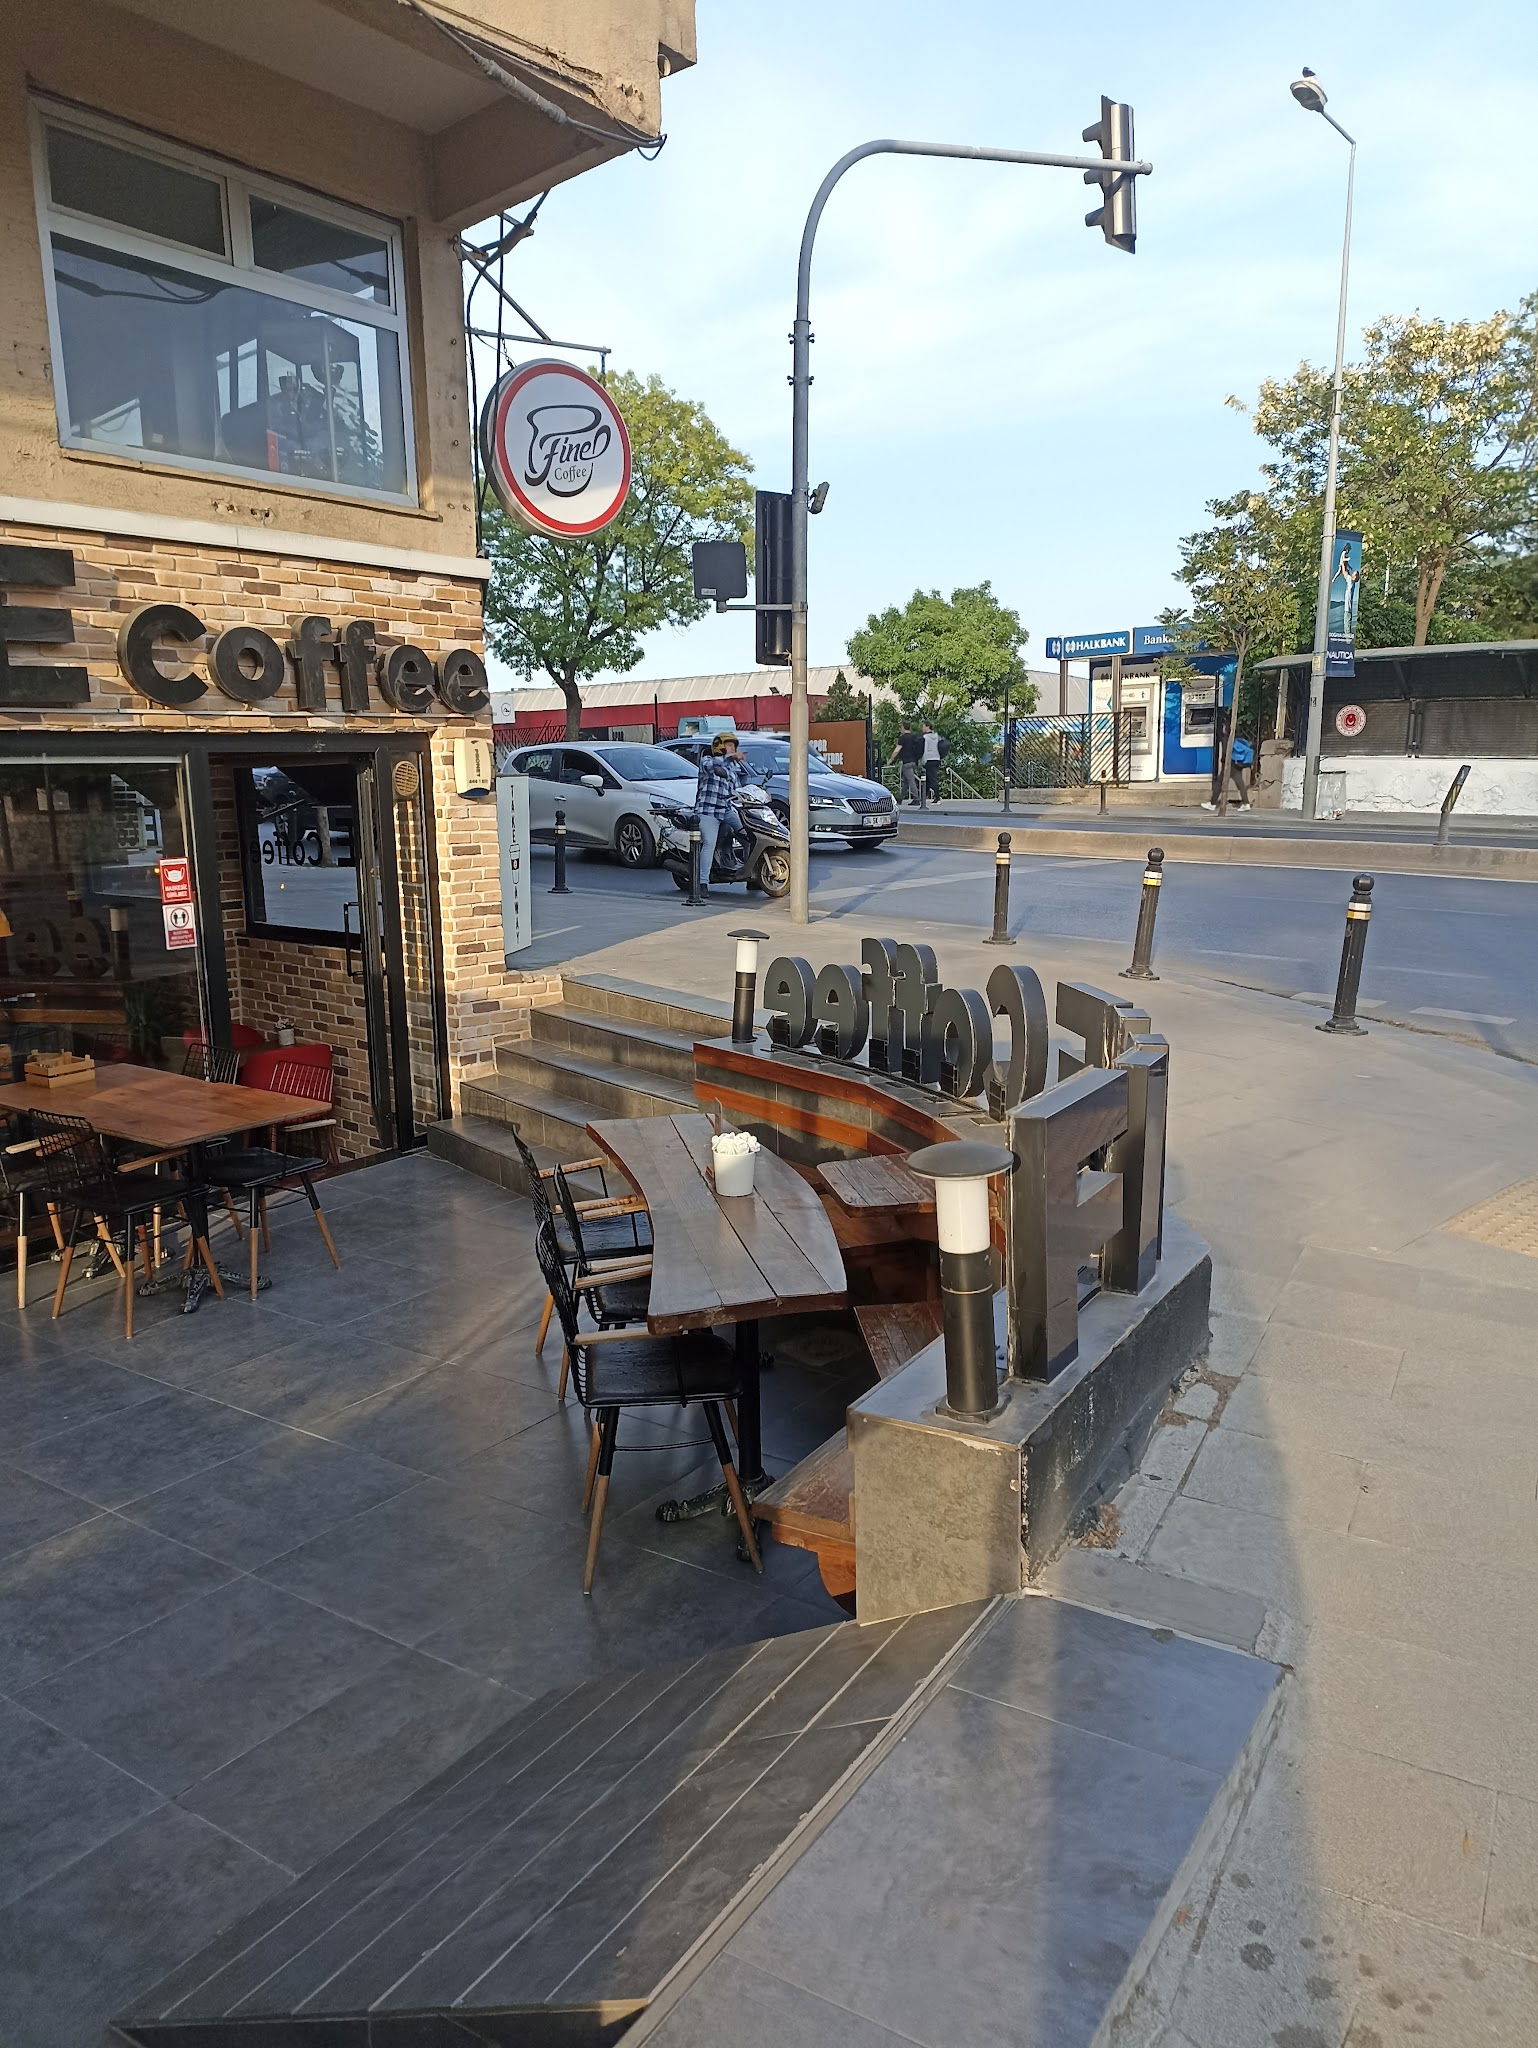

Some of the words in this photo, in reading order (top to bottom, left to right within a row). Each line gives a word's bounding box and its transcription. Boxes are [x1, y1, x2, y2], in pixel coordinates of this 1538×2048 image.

[554, 465, 587, 483] Coffee
[1076, 637, 1126, 651] HALKBANK
[117, 603, 491, 714] Coffee
[1327, 651, 1354, 660] NAUTICA
[1109, 671, 1151, 680] LKBANK
